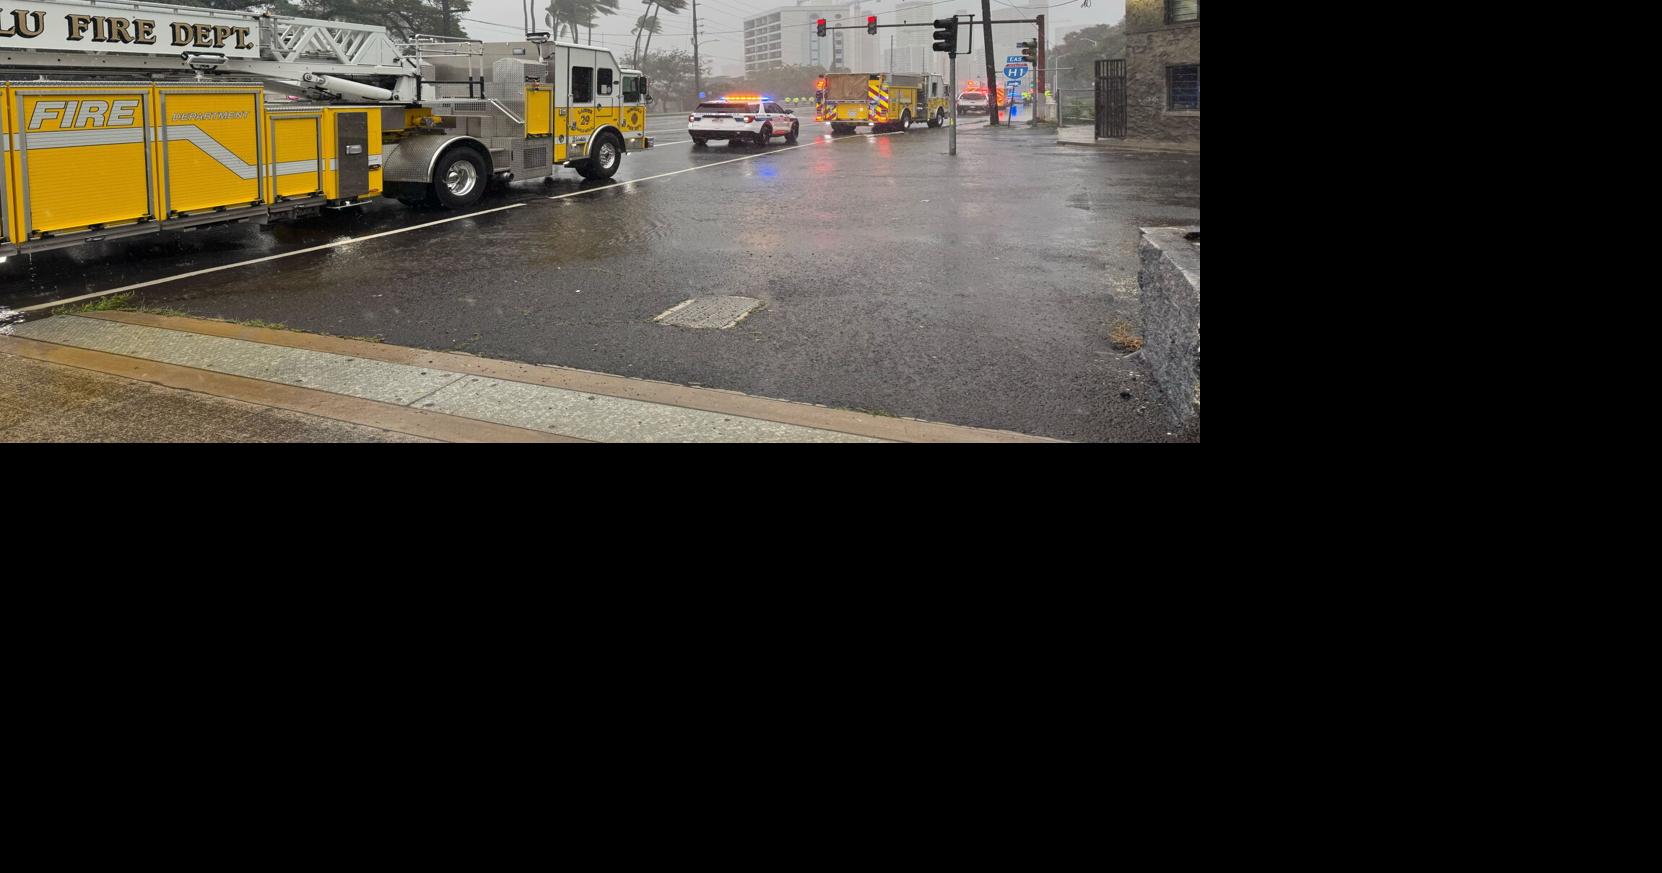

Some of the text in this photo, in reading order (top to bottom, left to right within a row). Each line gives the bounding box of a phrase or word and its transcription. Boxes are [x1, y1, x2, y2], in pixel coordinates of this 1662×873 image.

[66, 13, 156, 44] FIRE
[171, 22, 254, 50] DEPT.
[28, 99, 139, 130] FIRE
[172, 111, 248, 120] DEPARTMENT
